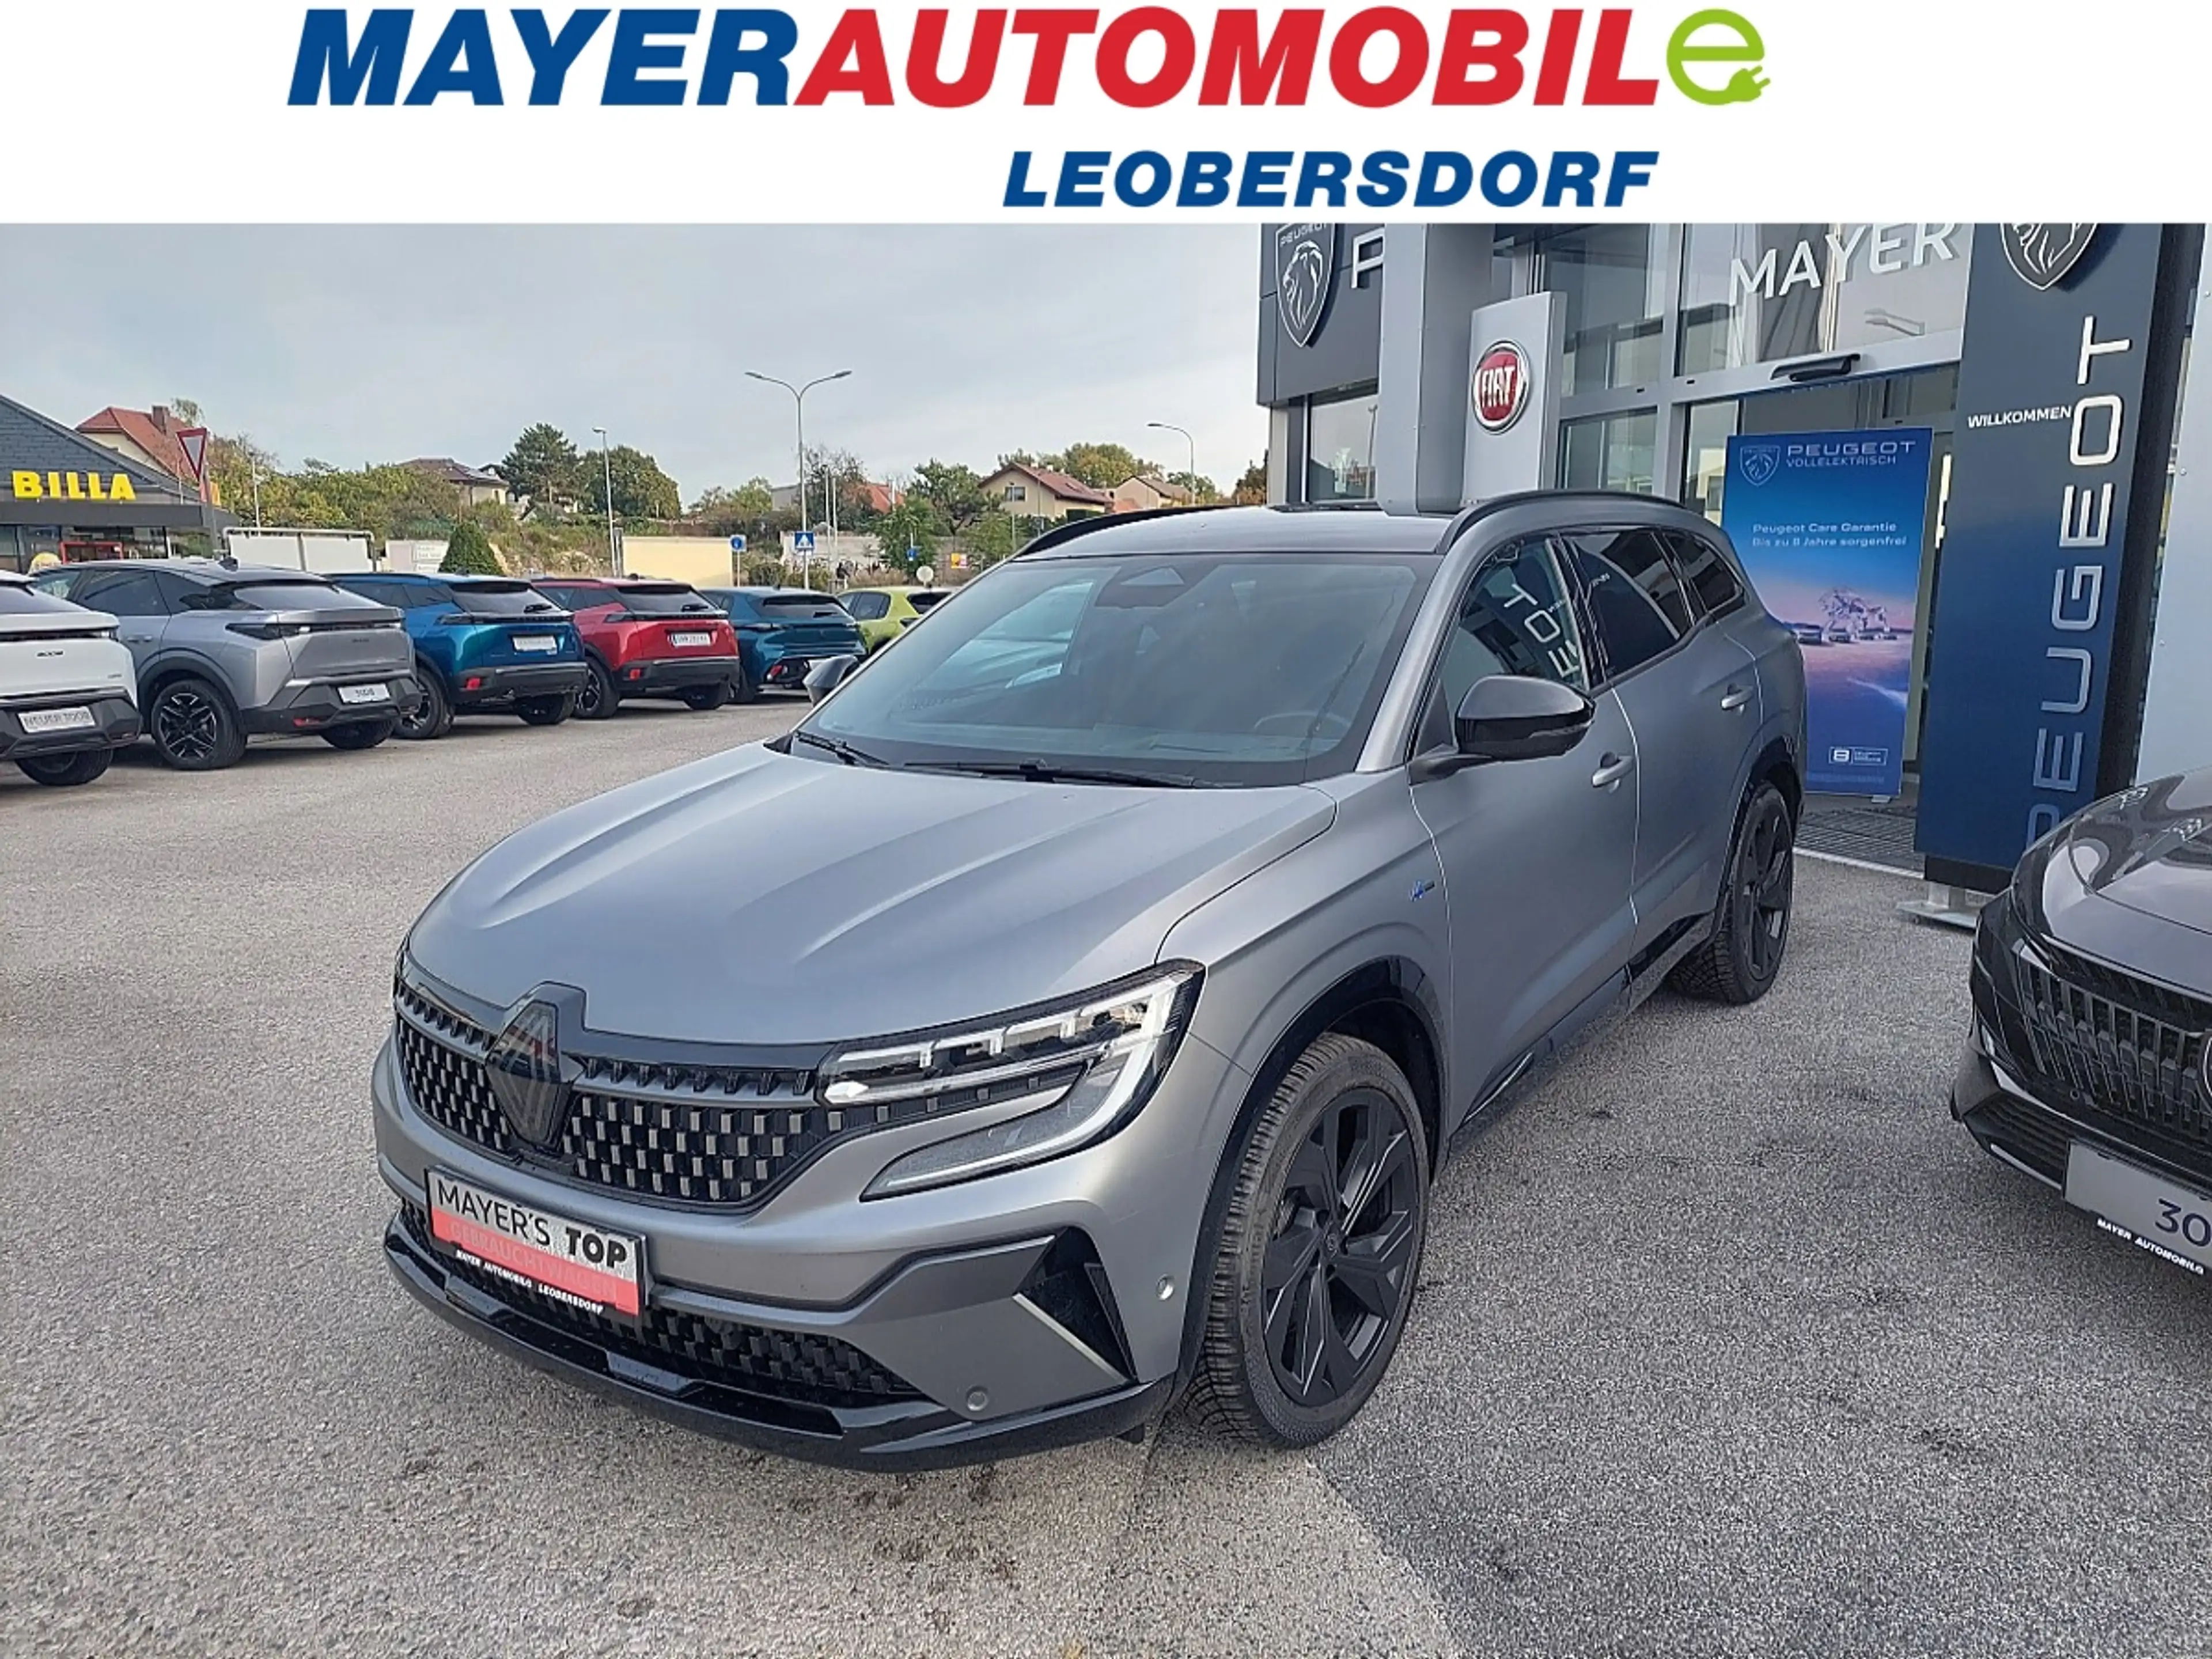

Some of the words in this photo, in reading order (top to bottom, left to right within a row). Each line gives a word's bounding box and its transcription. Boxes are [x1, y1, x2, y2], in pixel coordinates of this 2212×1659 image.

[1729, 224, 1953, 306] MAYER
[1482, 365, 1516, 408] FIAT
[1967, 405, 2072, 429] WILLKOMMEN
[1787, 441, 1916, 457] PEUGEOT
[1786, 455, 1896, 468] VOLLELEKTRISCH
[12, 471, 136, 501] BILLA
[1753, 524, 1805, 536] Peugeot
[1808, 523, 1837, 532] Care
[1841, 521, 1896, 532] Garantie
[1804, 537, 1836, 546] Jahre
[1839, 535, 1907, 548] sorgenfrei
[438, 1179, 550, 1247] MAYER'S
[566, 1227, 628, 1270] TOP
[2097, 1217, 2132, 1240] MAYER
[537, 1283, 604, 1316] LEOBERSDORF
